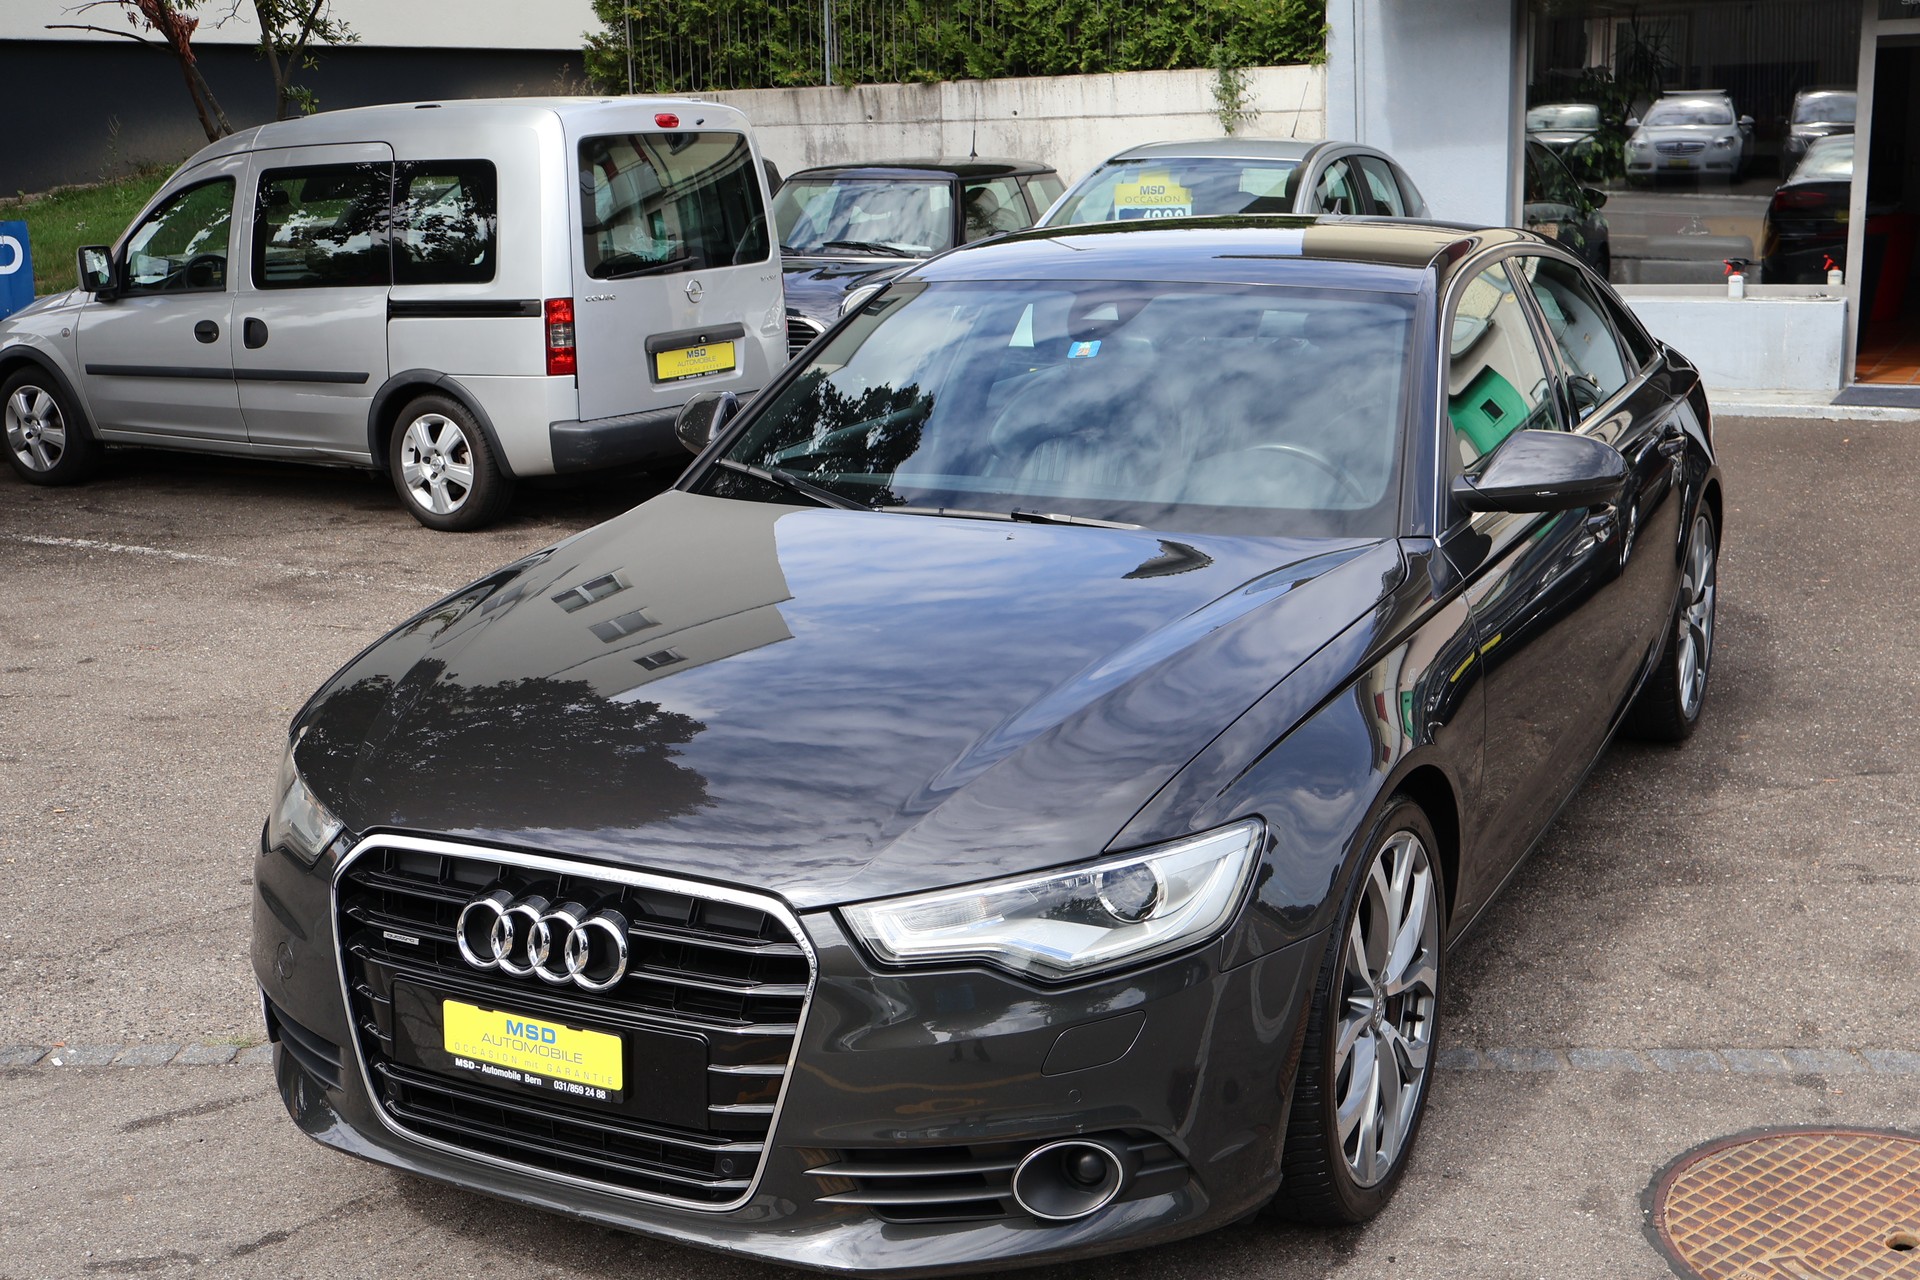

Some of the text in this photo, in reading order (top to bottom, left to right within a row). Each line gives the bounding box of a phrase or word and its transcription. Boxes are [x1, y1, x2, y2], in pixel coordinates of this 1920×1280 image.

[1124, 195, 1181, 204] OCCASION
[1139, 185, 1166, 195] MSD
[686, 348, 706, 359] MSD
[506, 1019, 556, 1044] MSD
[481, 1033, 583, 1064] AUTOMOBILE
[454, 1041, 614, 1086] OCCASION mit GARANTIE
[524, 1073, 542, 1086] Bern
[553, 1080, 584, 1095] 031/859
[585, 1087, 595, 1097] 24
[596, 1089, 606, 1100] 88
